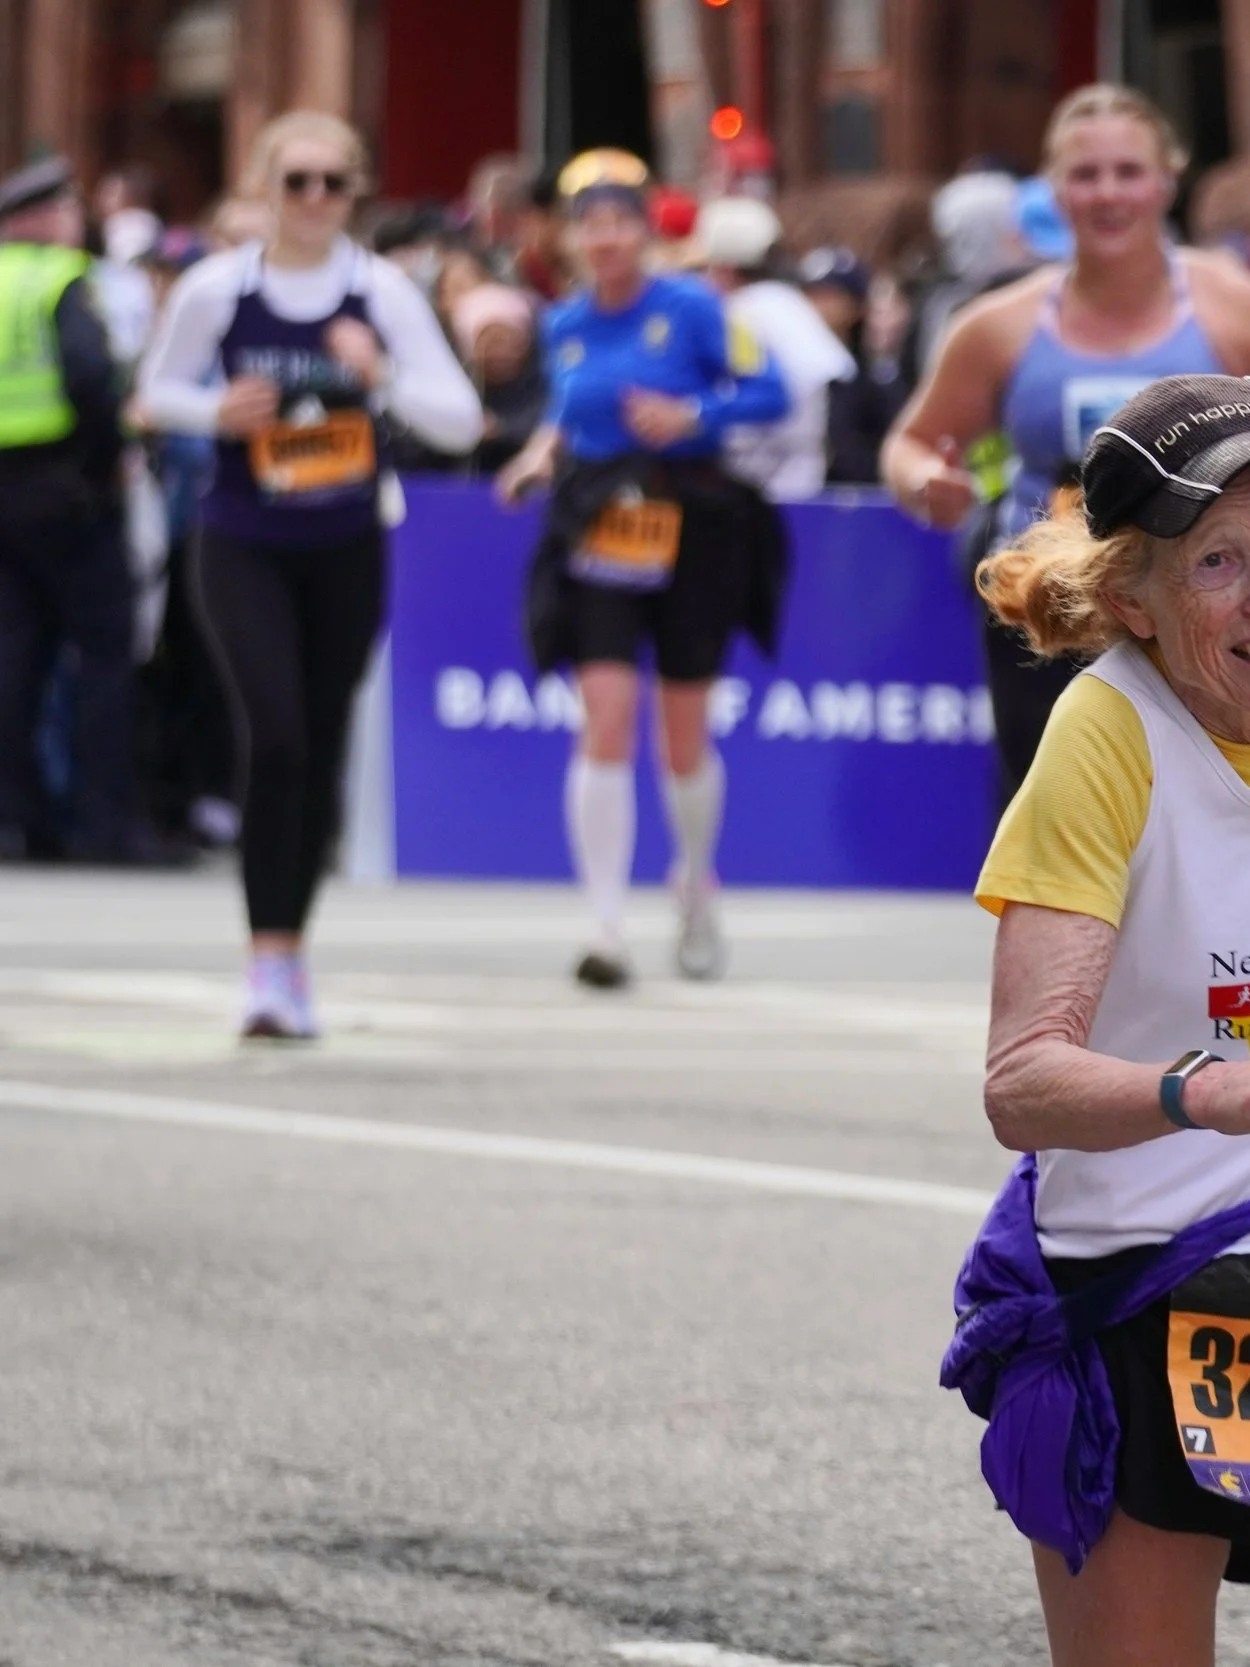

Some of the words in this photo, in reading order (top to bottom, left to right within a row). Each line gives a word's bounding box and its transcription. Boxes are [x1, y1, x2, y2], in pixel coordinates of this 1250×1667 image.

[1154, 421, 1191, 454] run
[435, 667, 588, 731] BAN
[757, 680, 996, 744] AMERI
[1186, 1427, 1207, 1452] 7
